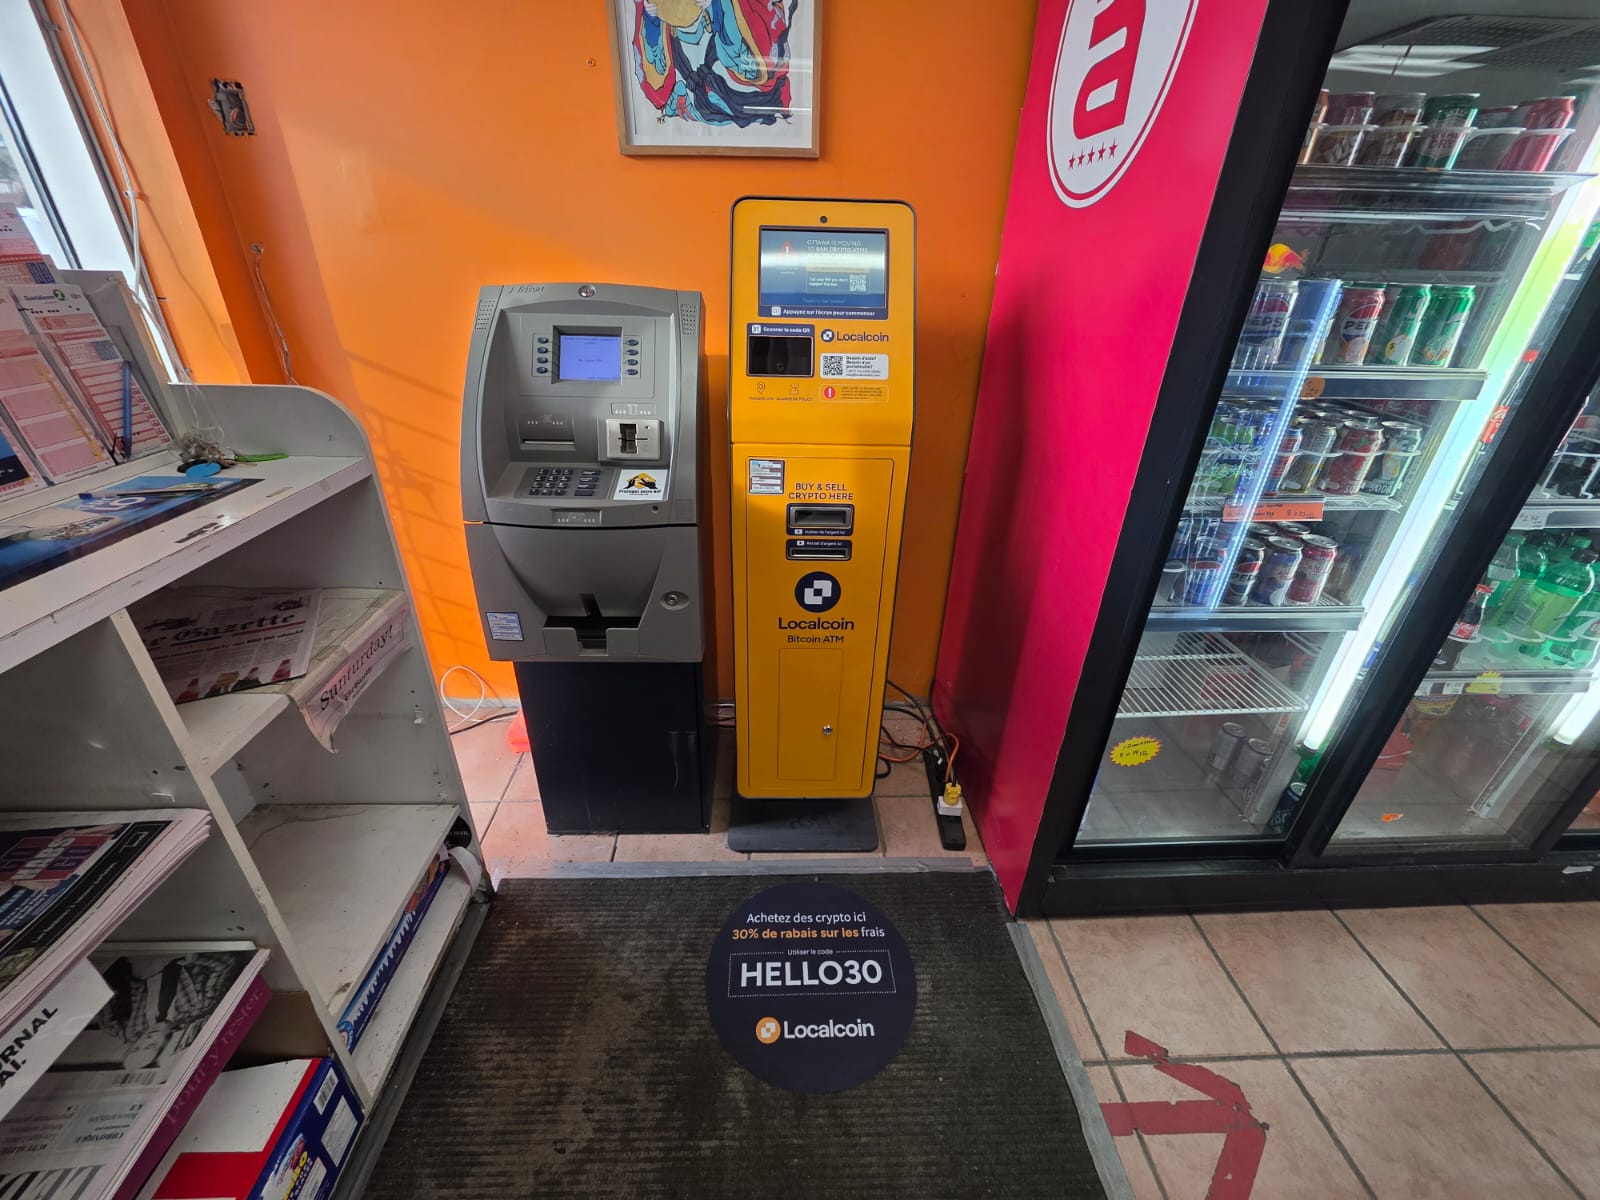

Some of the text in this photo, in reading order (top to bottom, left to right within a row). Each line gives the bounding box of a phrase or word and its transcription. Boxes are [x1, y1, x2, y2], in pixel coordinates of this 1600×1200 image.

[836, 331, 889, 343] Localcoin
[795, 482, 847, 492] BUY & SELL
[788, 491, 854, 501] CRYPTO HERE
[778, 616, 855, 630] Localcoin
[787, 634, 844, 644] Bitcoin ATM
[11, 837, 77, 880] HABS
[746, 911, 867, 925] Achetez des crypto ici
[732, 926, 886, 940] 30% de rabais sur les frais
[787, 948, 809, 956] Utiliser
[810, 948, 816, 956] le
[740, 960, 883, 988] HELLO30
[783, 1018, 875, 1039] Localcoin
[0, 1007, 59, 1070] RNAL
